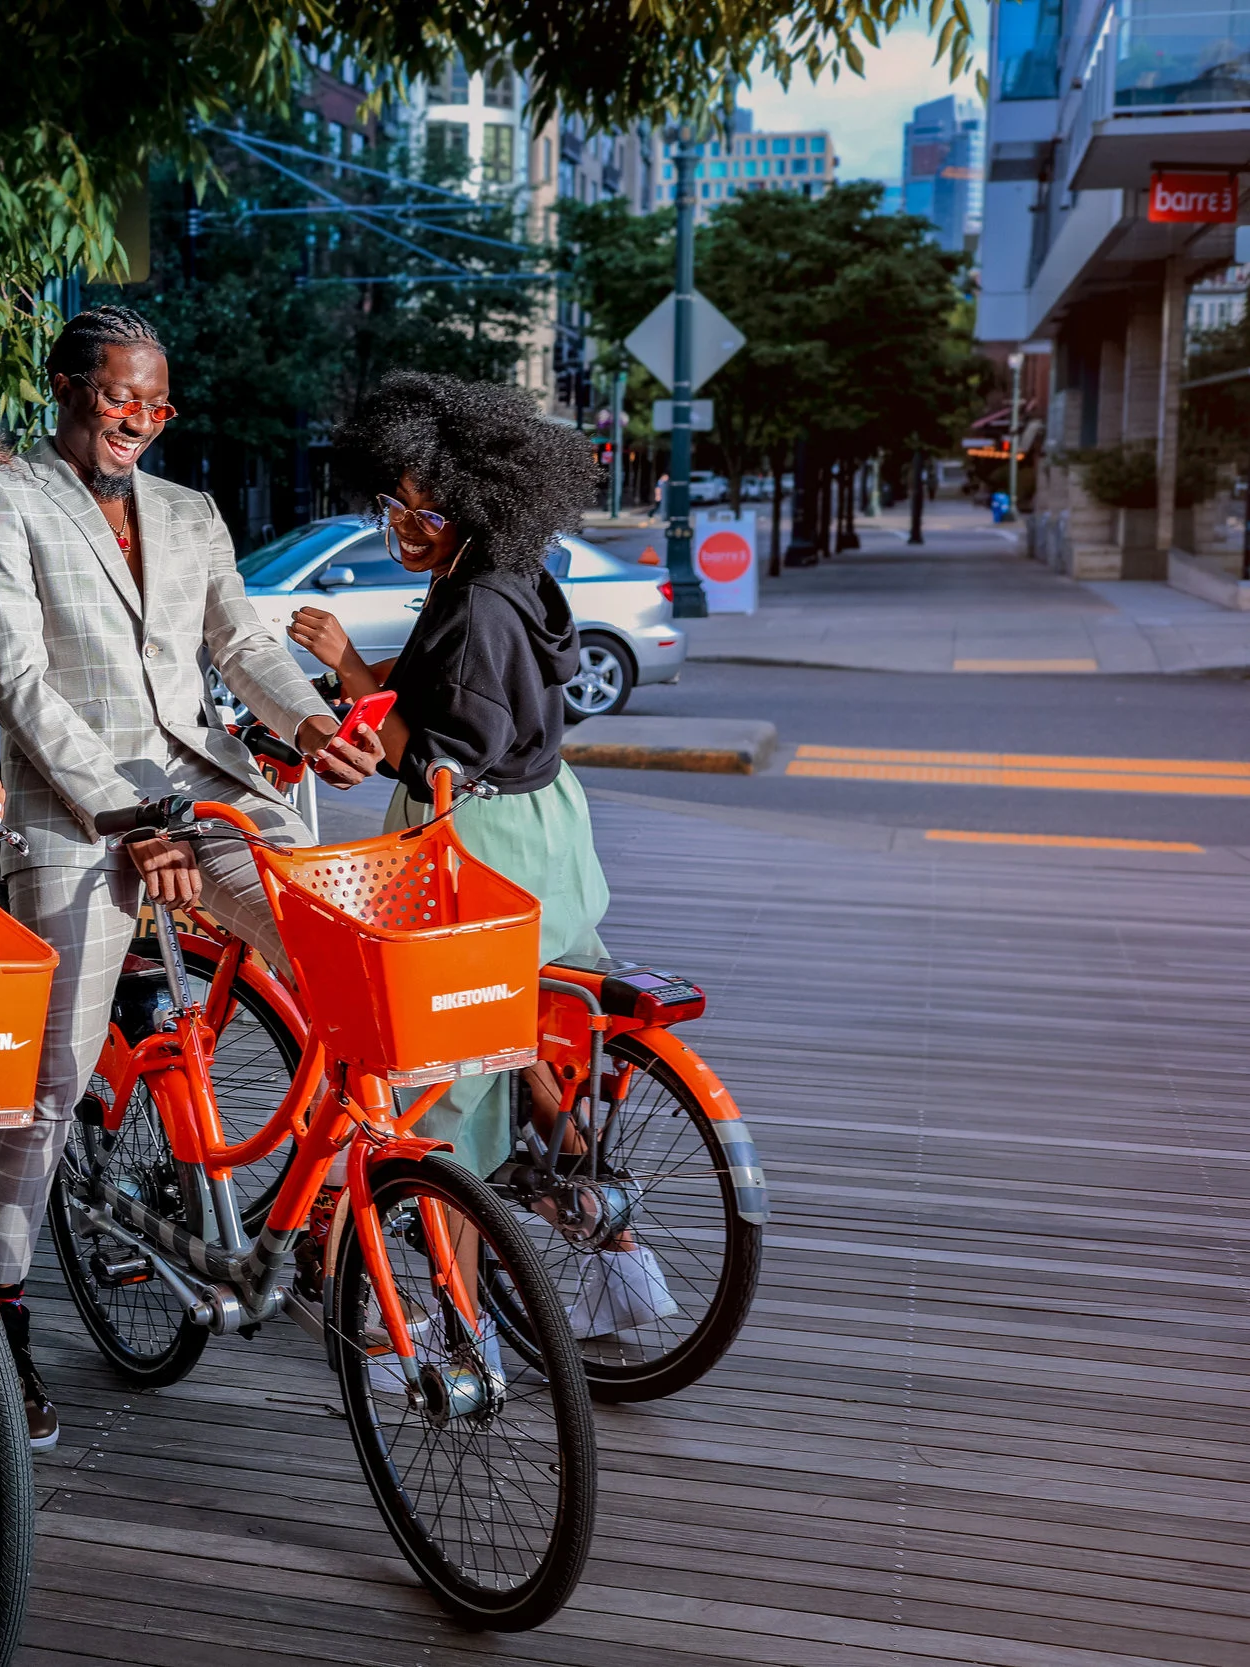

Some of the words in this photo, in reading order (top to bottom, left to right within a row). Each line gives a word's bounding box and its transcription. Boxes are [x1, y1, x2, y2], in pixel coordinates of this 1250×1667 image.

[166, 925, 175, 935] 2
[170, 942, 178, 952] 3
[174, 959, 182, 969] 4
[178, 976, 185, 986] 5
[431, 983, 508, 1012] BIKETOWN
